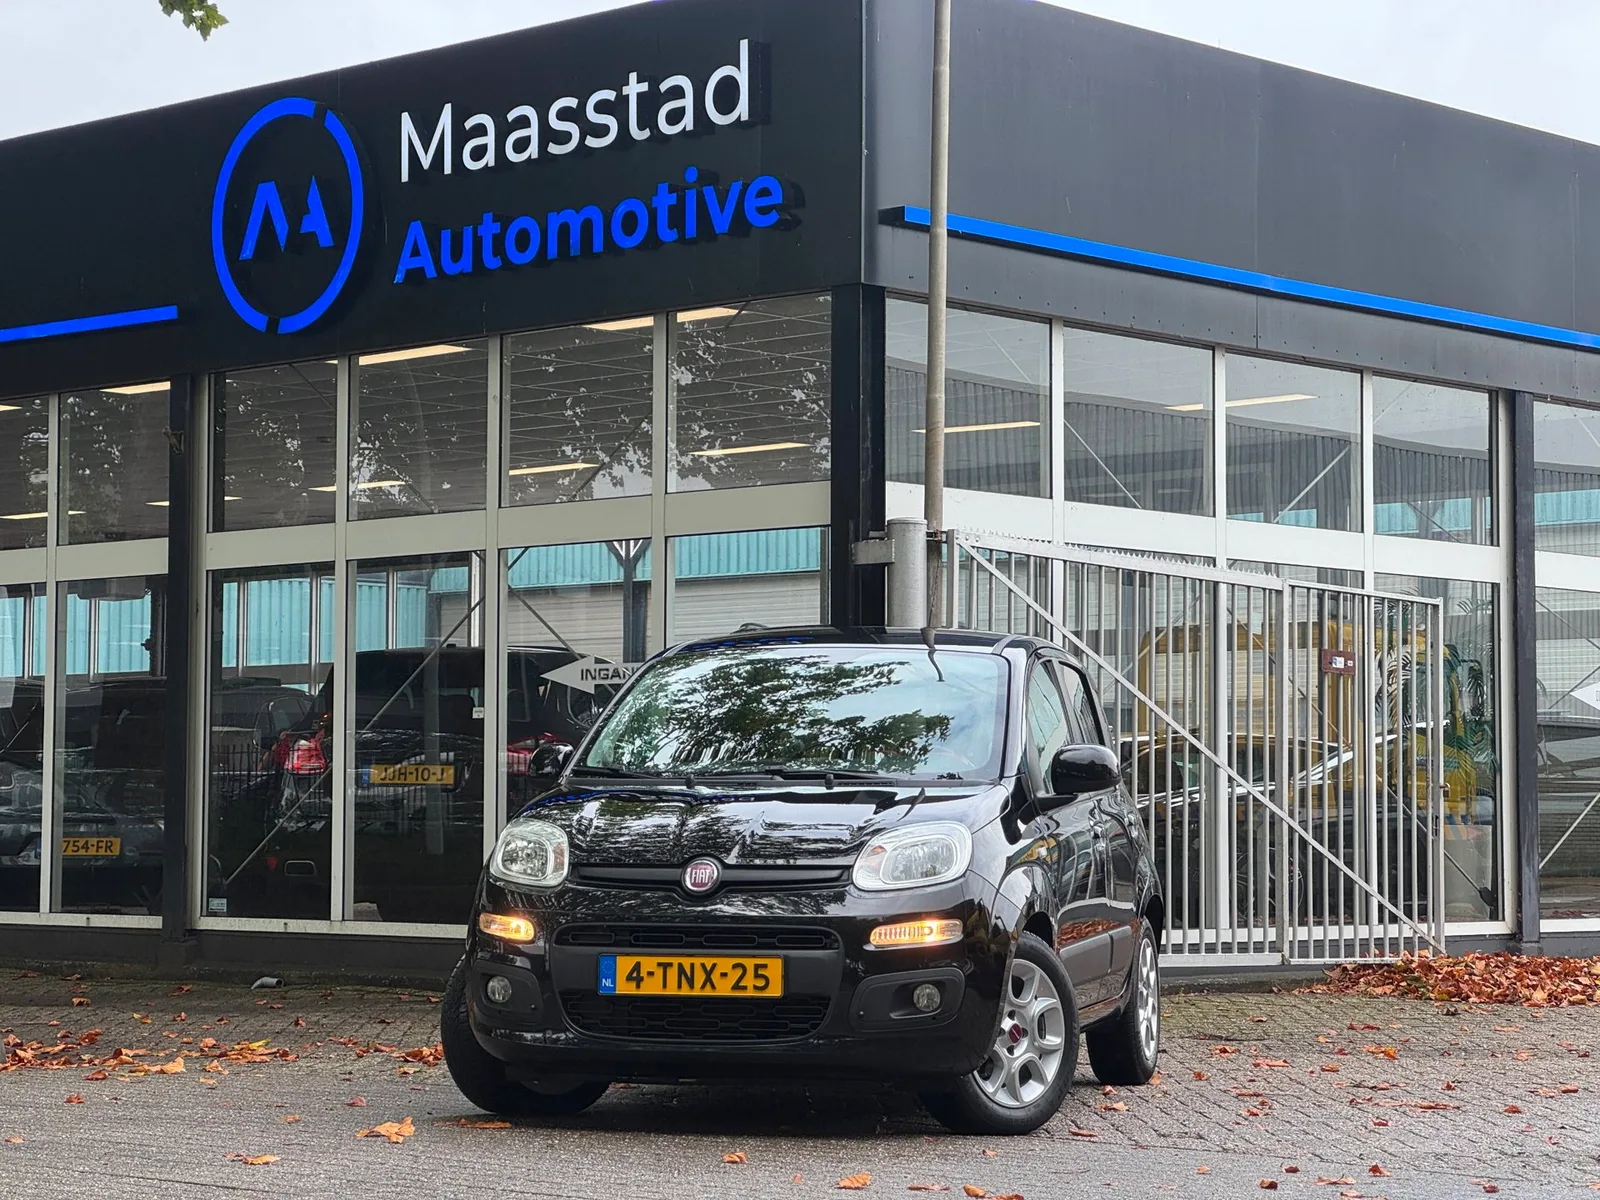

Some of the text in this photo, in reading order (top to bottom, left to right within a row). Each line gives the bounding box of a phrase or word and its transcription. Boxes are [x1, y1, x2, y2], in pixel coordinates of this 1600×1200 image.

[401, 38, 750, 182] Maasstad
[393, 166, 784, 284] Automotive
[580, 666, 640, 681] INGAN
[691, 869, 710, 883] FIAT
[602, 961, 770, 991] NL 4-TNX-25
